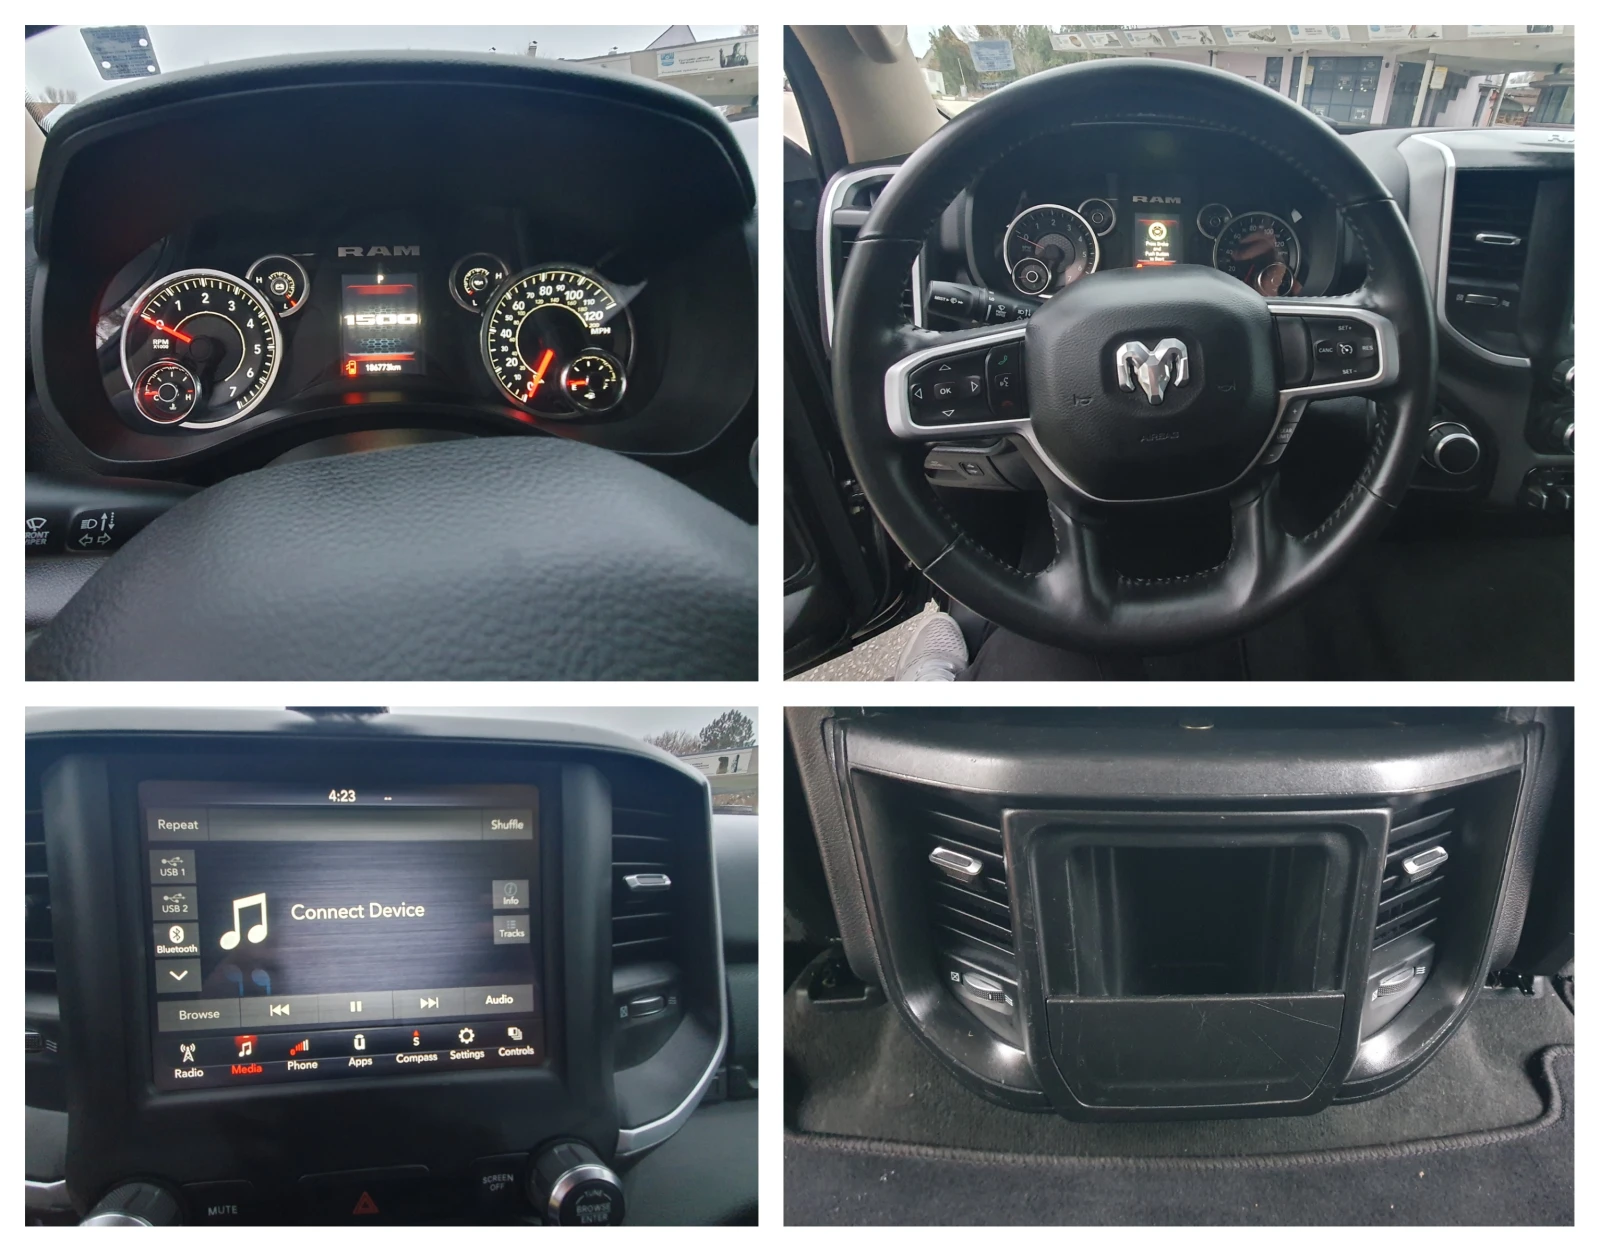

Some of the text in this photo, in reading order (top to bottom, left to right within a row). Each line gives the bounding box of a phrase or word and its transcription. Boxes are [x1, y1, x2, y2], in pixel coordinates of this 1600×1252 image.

[1132, 195, 1182, 204] RAM
[337, 245, 421, 258] RAM
[255, 276, 263, 284] H
[376, 274, 385, 285] P
[495, 272, 503, 280] H
[539, 285, 553, 297] 80
[555, 284, 566, 292] 90
[201, 292, 210, 304] 2
[526, 292, 536, 300] 70
[564, 289, 584, 301] 100
[174, 300, 182, 311] 1
[228, 300, 236, 312] 3
[472, 299, 478, 307] L
[512, 300, 526, 311] 60
[583, 298, 596, 306] 110
[343, 313, 418, 326] 1500
[505, 314, 514, 322] 50
[583, 310, 604, 321] 120
[155, 319, 165, 331] 0
[247, 318, 255, 329] 4
[500, 328, 513, 339] 40
[590, 327, 612, 335] MPH
[152, 338, 169, 346] RPM
[254, 344, 262, 355] 5
[505, 357, 519, 367] 20
[246, 366, 255, 378] 6
[514, 373, 522, 381] 10
[229, 386, 237, 397] 7
[939, 387, 952, 395] OK
[185, 393, 192, 401] H
[328, 789, 356, 803] 4:23
[157, 818, 199, 832] Repeat
[491, 819, 524, 831] Shuffle
[159, 867, 186, 877] USB 1
[502, 896, 520, 906] Info
[161, 904, 189, 914] USB 2
[290, 901, 426, 921] Connect Device
[498, 929, 525, 939] Tracks
[156, 945, 198, 955] Bluetooth
[485, 993, 514, 1006] Audio
[178, 1009, 221, 1022] Browse
[412, 1036, 420, 1047] S
[449, 1049, 486, 1062] Settings
[497, 1044, 535, 1057] Controls
[348, 1056, 373, 1069] Apps
[395, 1052, 439, 1065] Compass
[231, 1063, 263, 1075] Media
[287, 1060, 319, 1071] Phone
[174, 1067, 204, 1080] Radio
[482, 1173, 514, 1185] SCREEN
[489, 1183, 505, 1192] OFF
[584, 1189, 604, 1198] TUNE
[207, 1204, 239, 1217] MUTE
[576, 1202, 612, 1214] BROWSE
[580, 1213, 609, 1224] ENTER
